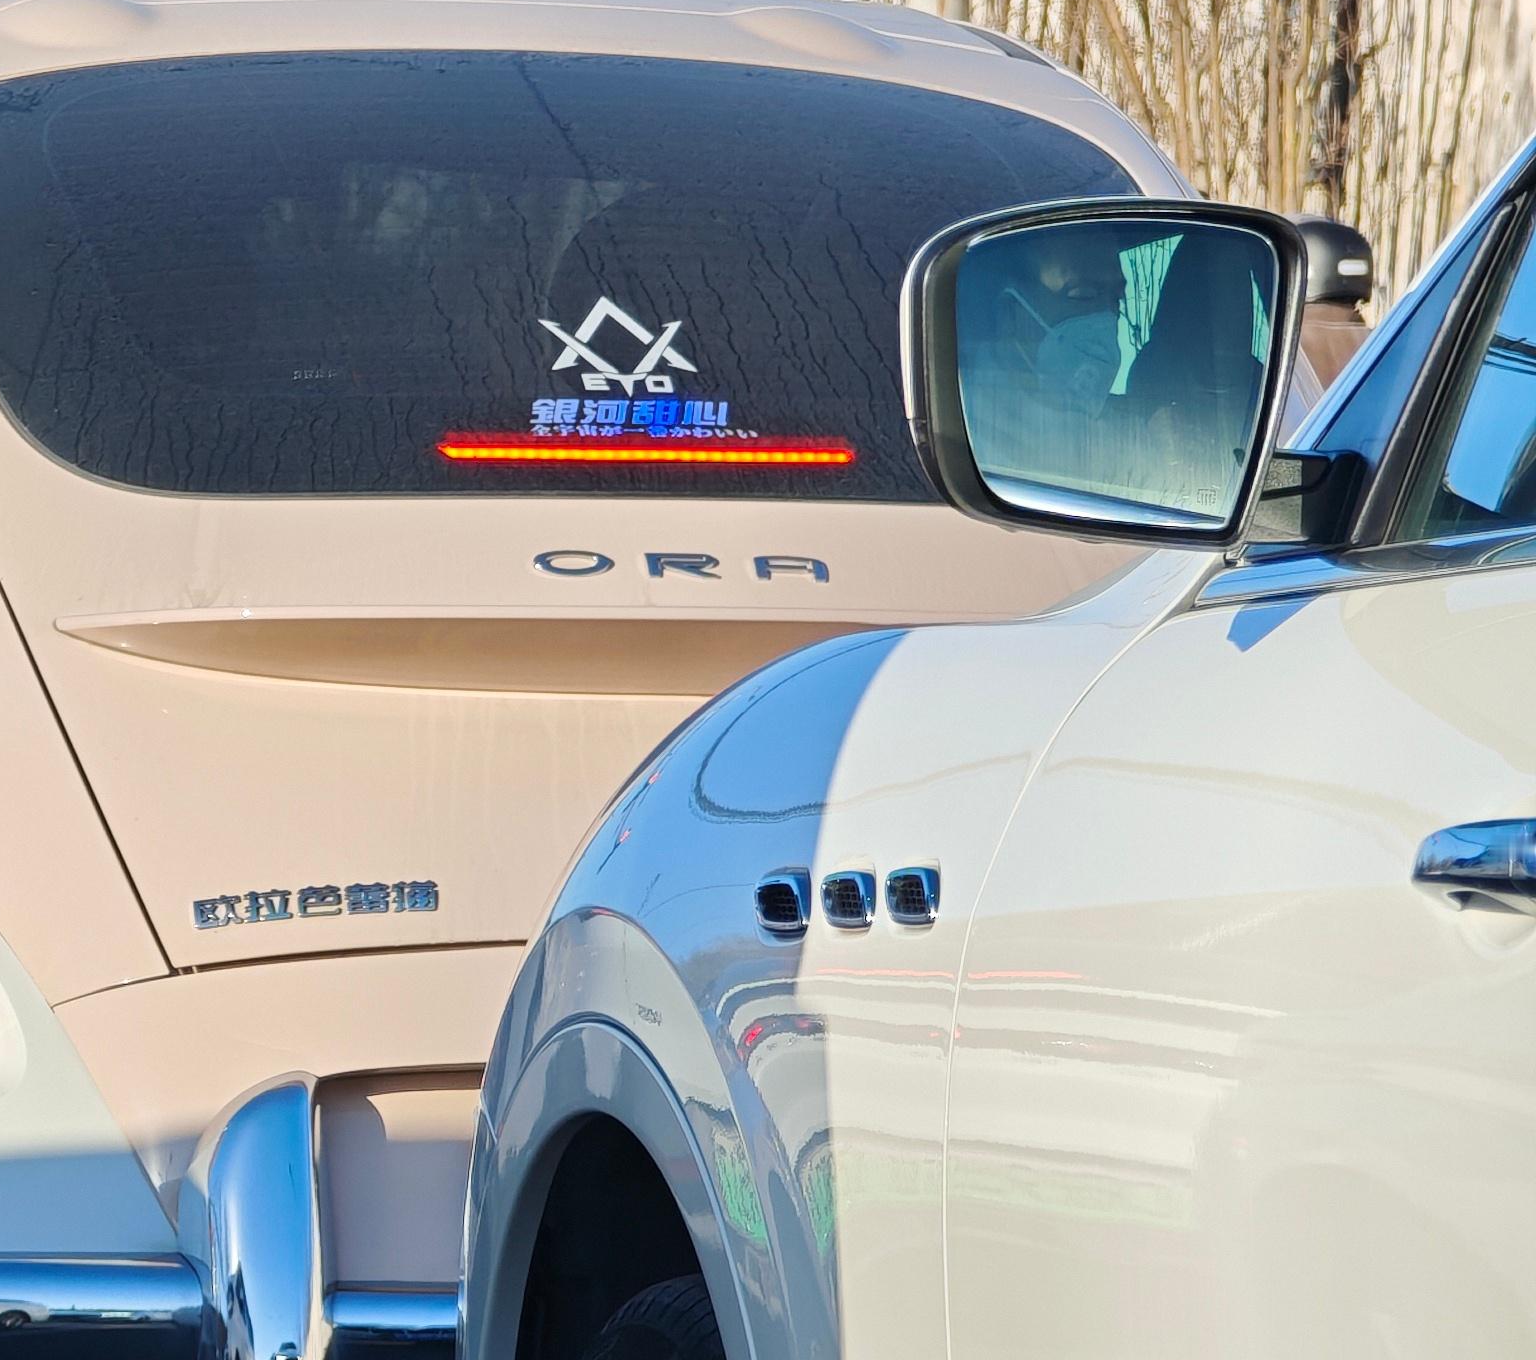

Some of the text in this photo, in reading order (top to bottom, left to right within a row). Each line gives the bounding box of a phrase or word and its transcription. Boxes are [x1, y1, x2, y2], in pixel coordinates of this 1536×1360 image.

[529, 398, 728, 426] 銀河甜心
[532, 549, 830, 584] ORA
[192, 880, 440, 931] 欧拉芭蕾猫
